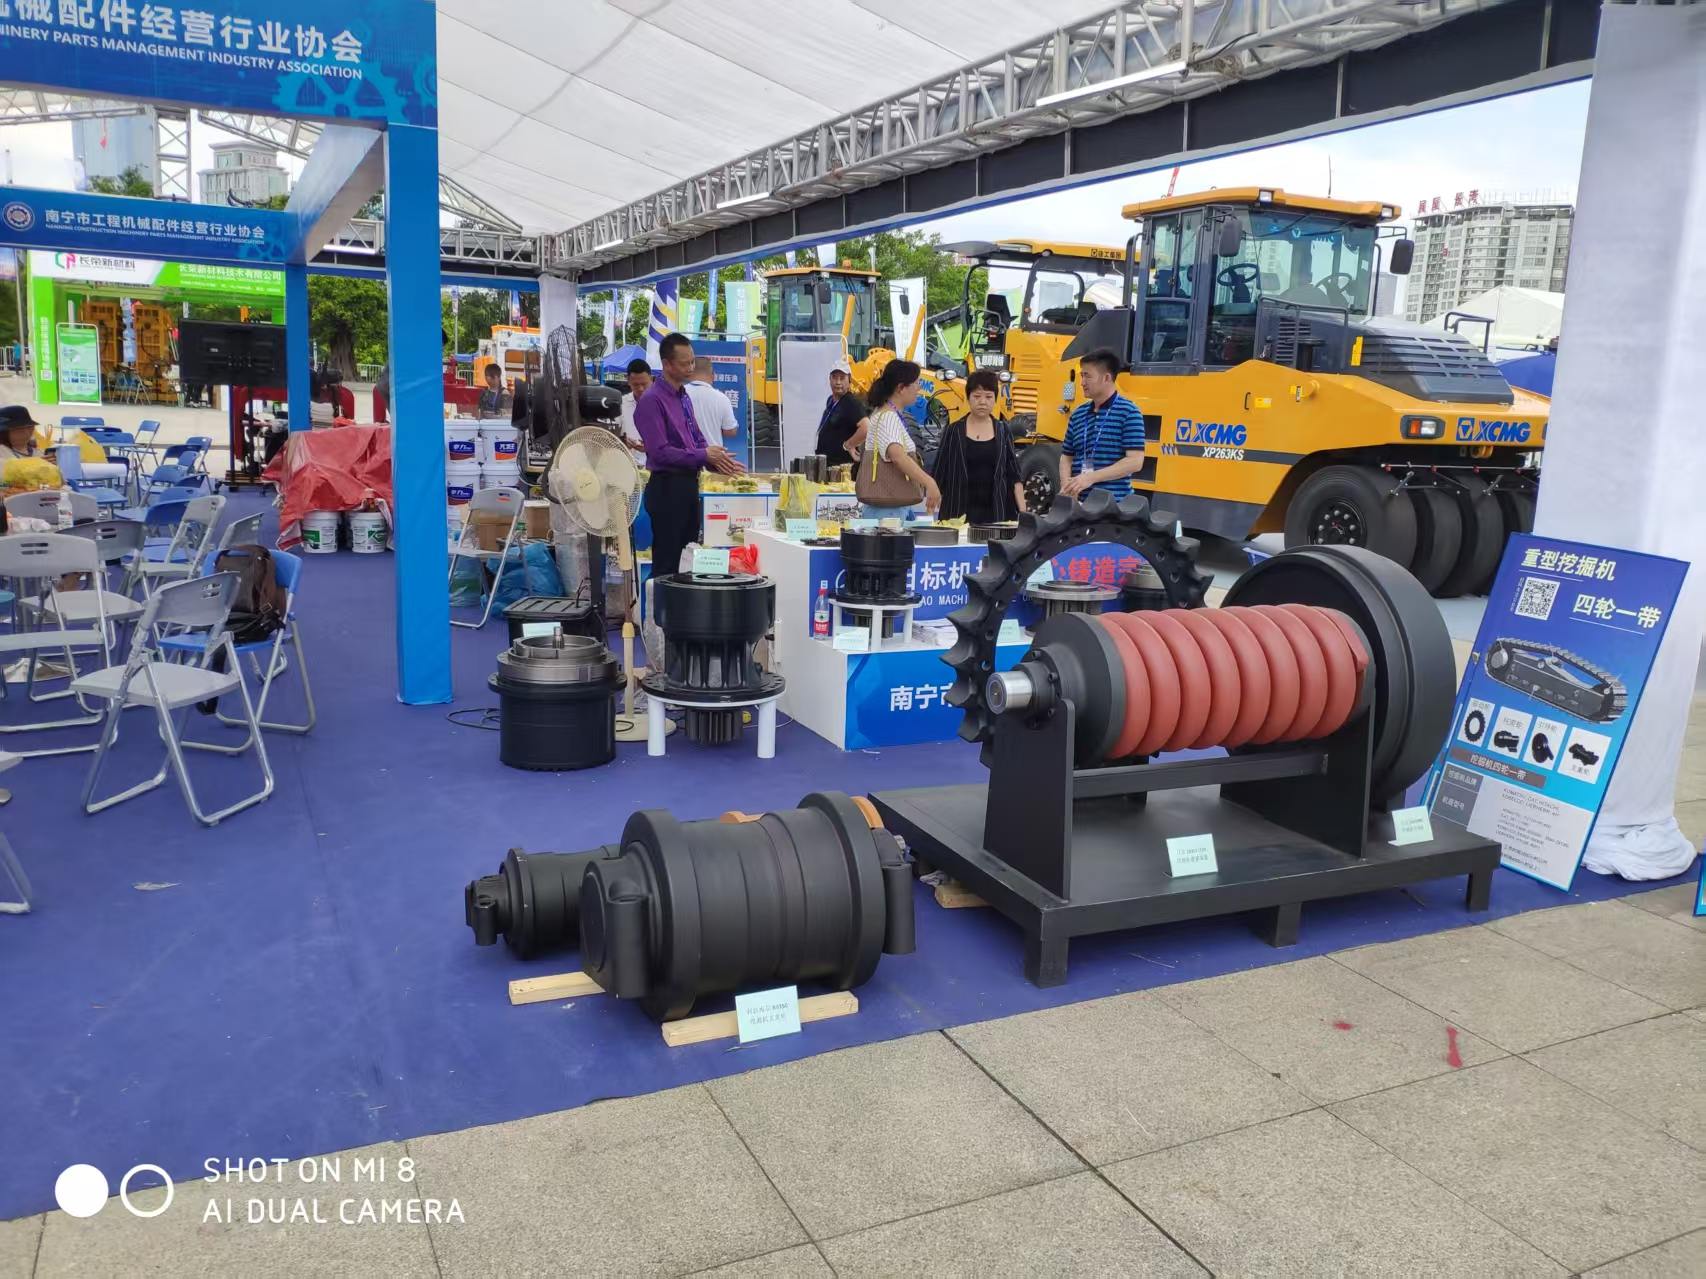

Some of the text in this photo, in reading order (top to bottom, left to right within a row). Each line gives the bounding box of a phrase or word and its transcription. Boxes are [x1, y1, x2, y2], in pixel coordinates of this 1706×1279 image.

[53, 31, 99, 48] PARTS
[101, 38, 205, 61] MANAGEMENT
[208, 51, 275, 70] INDUSTRY
[277, 60, 363, 80] ASSOCIATION
[45, 209, 265, 240] 南宁市工程机械配件经营行业协会
[1193, 422, 1247, 446] XCMG
[1473, 420, 1531, 443] XCMG
[1202, 446, 1245, 461] XP263KS
[1520, 548, 1617, 581] 重型挖掘机
[1573, 594, 1661, 629] 四轮一带
